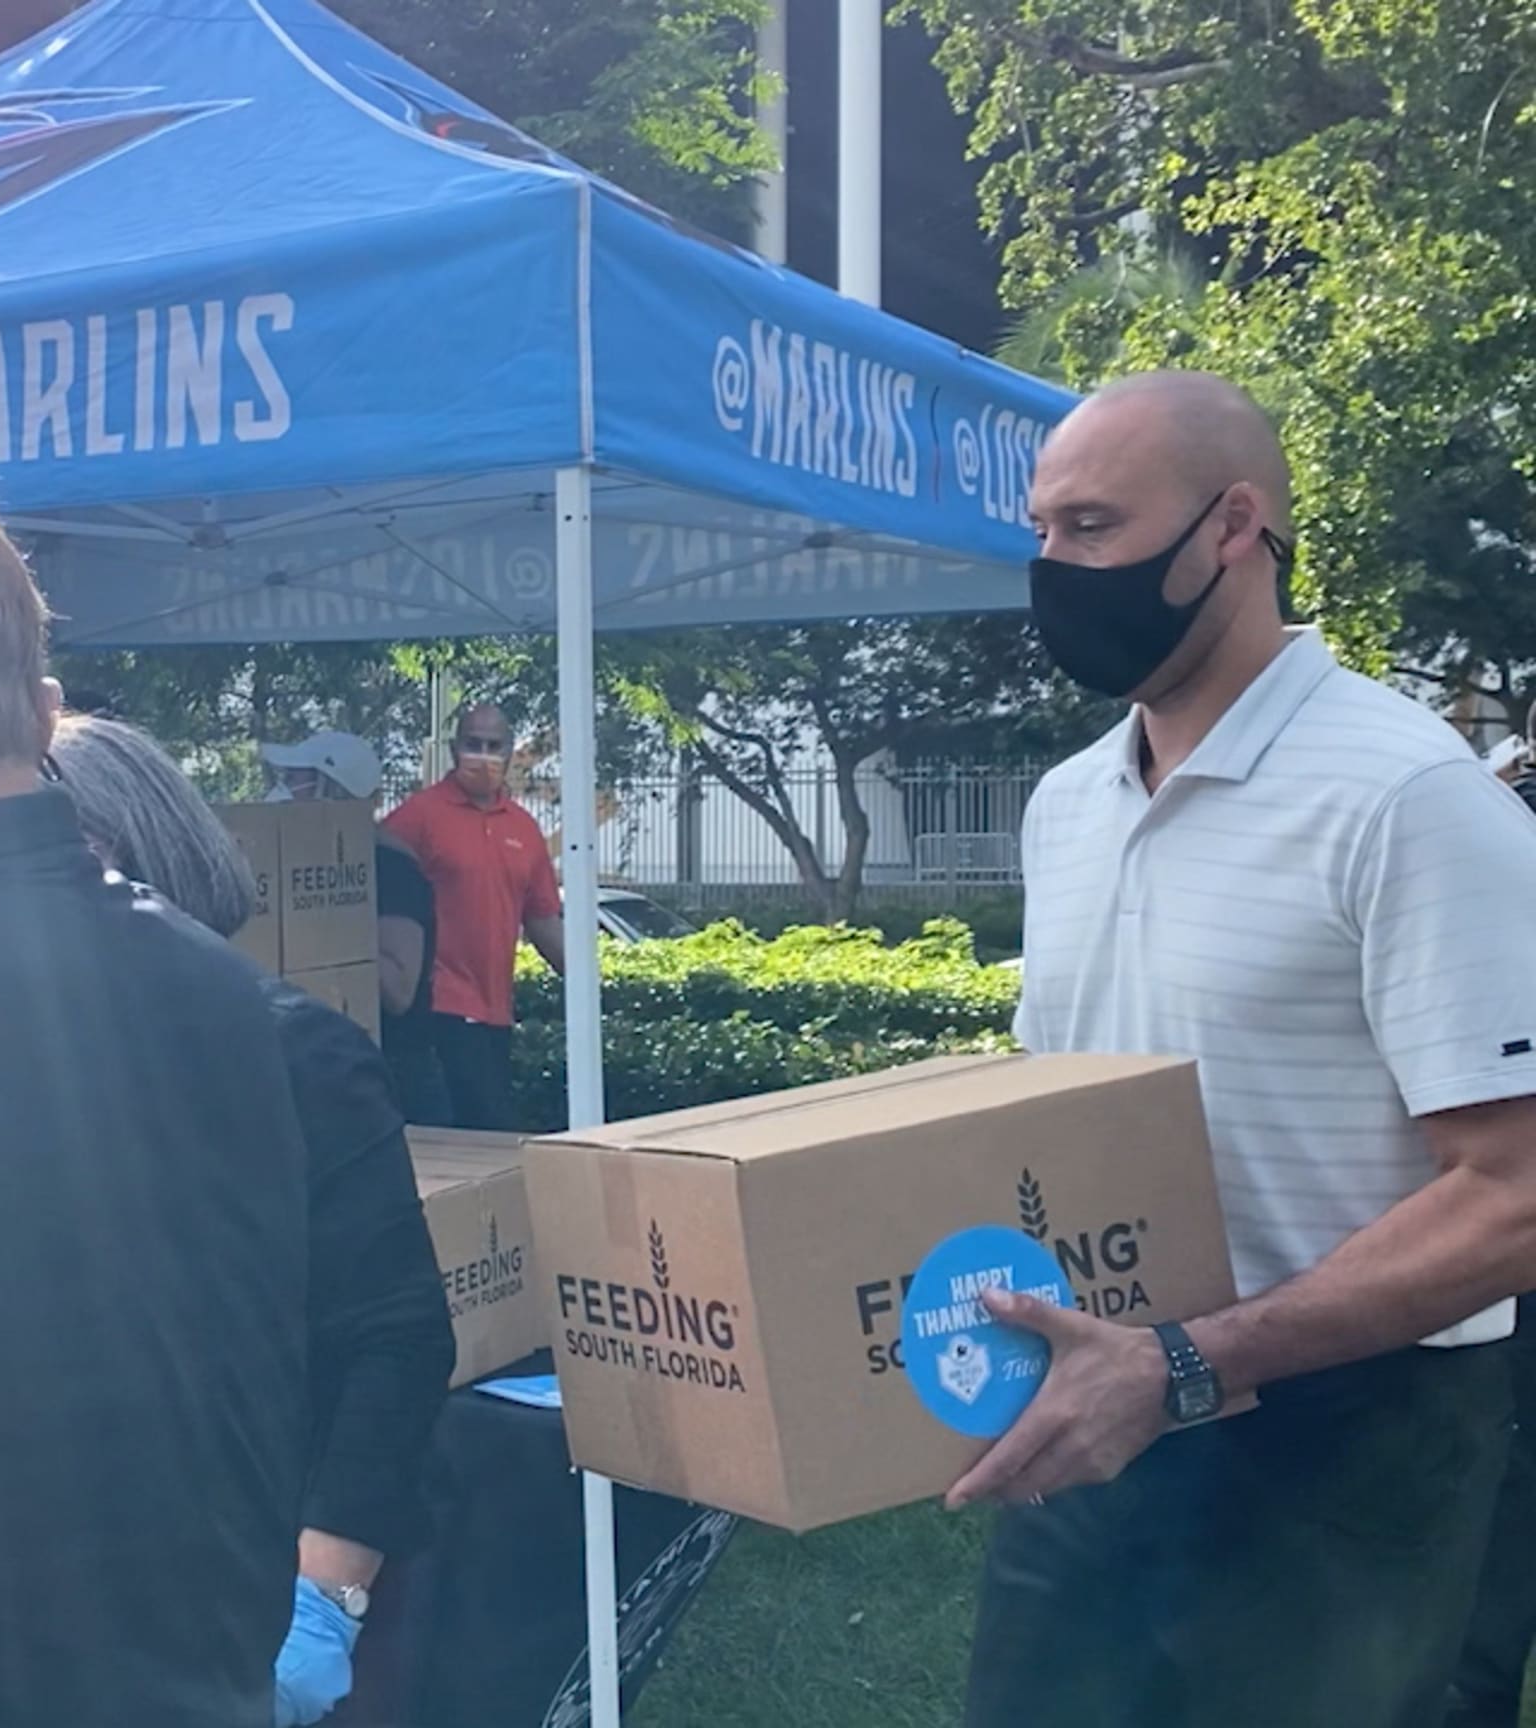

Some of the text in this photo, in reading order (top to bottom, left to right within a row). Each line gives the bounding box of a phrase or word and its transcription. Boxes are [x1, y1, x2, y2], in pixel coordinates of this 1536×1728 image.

[712, 318, 1046, 529] @MARLINS @LOS
[291, 863, 367, 893] FEEDING
[443, 1245, 523, 1296] FEEDING
[449, 1295, 478, 1319] OUTH
[556, 1274, 735, 1351] FEEDING
[565, 1327, 747, 1393] SOUTH FLORIDA
